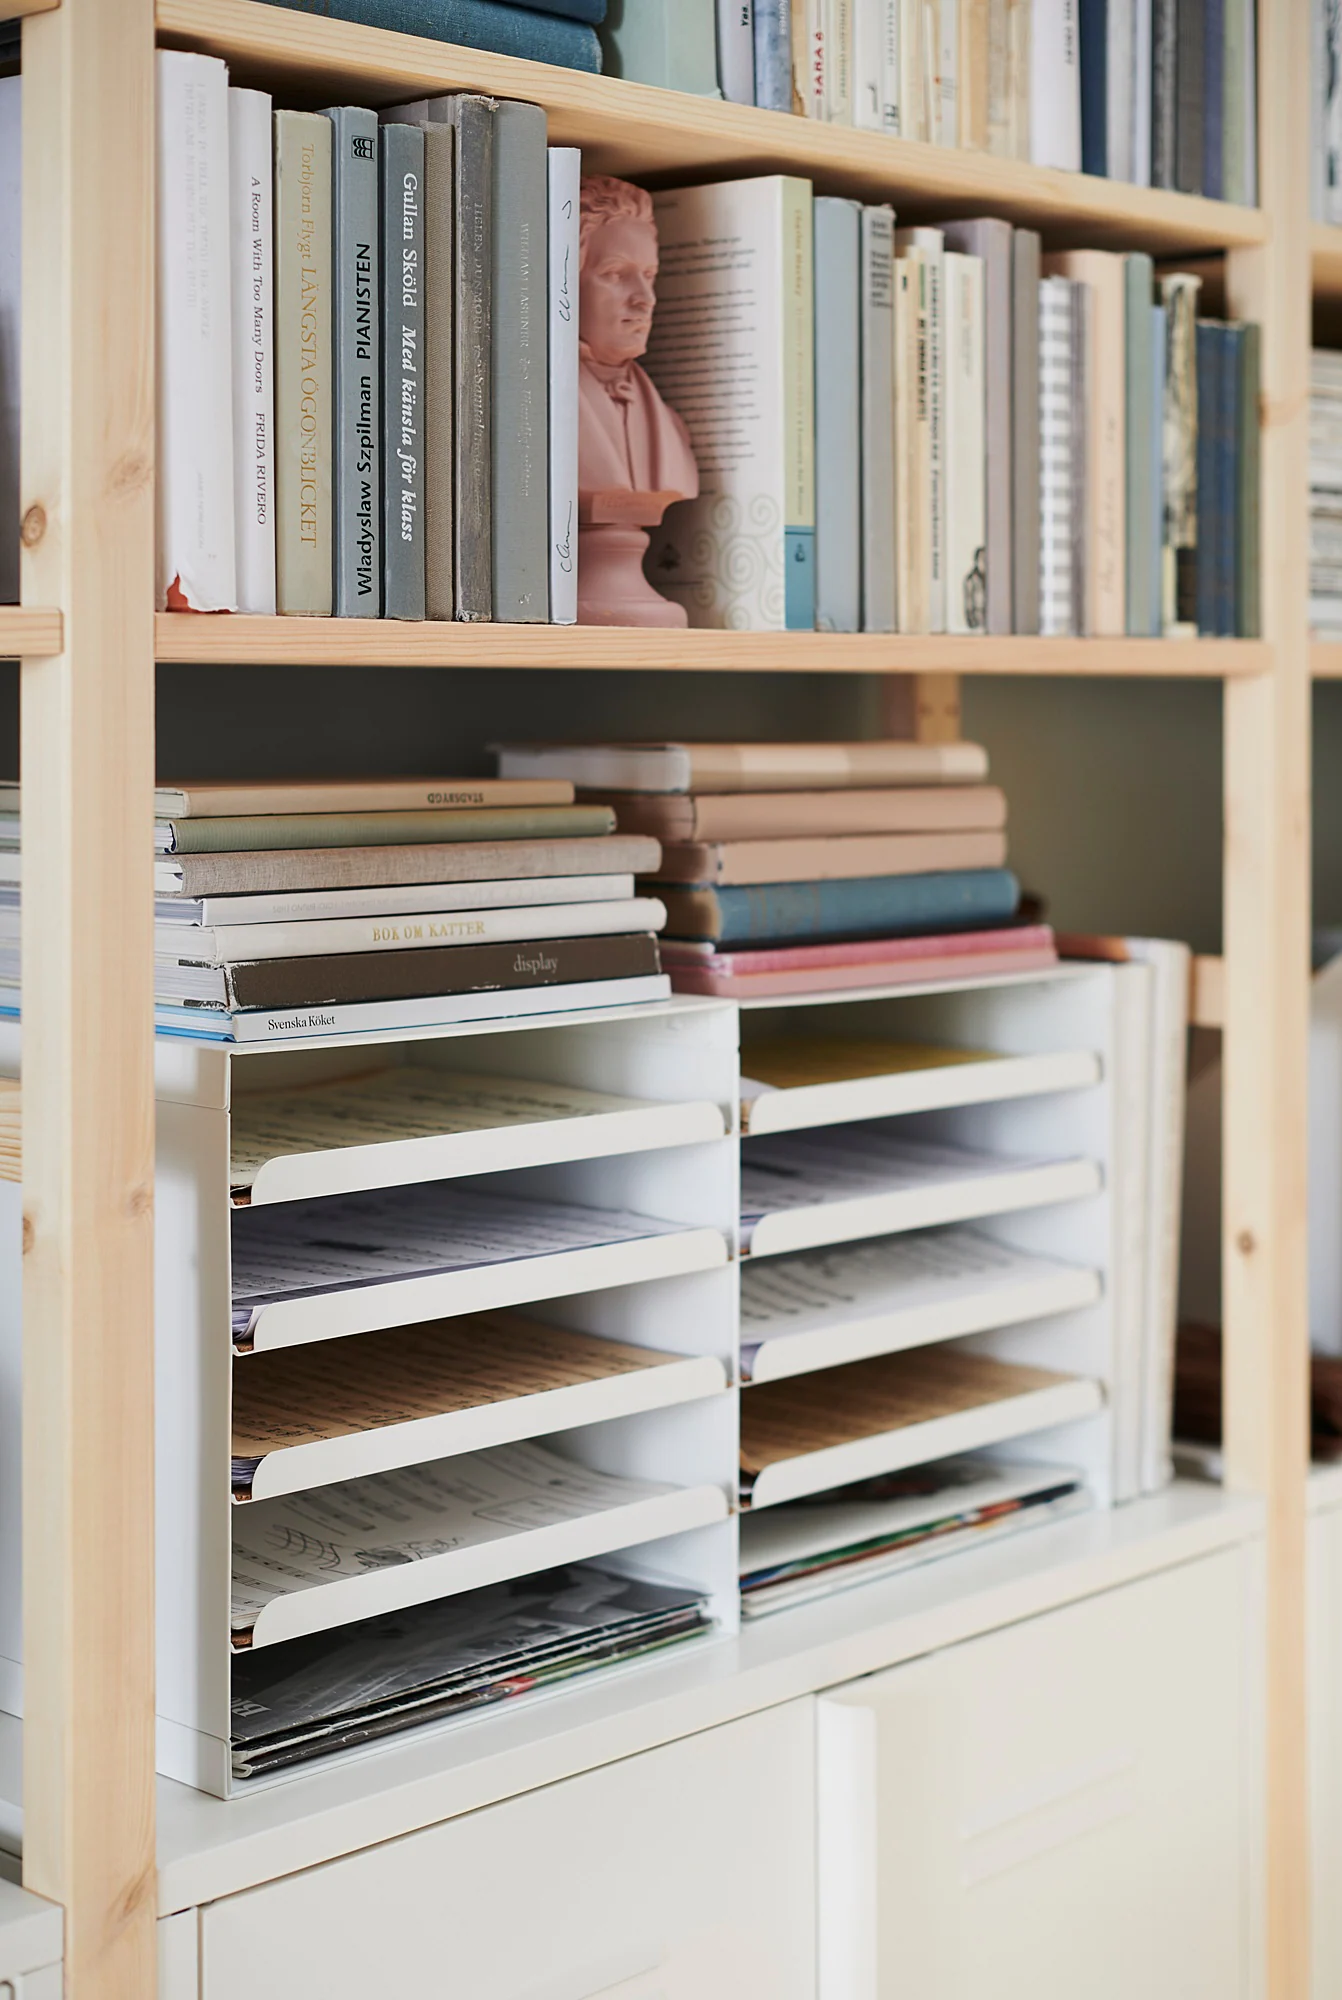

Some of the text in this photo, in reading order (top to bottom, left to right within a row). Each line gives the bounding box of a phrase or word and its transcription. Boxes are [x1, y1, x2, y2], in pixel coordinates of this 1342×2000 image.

[474, 202, 484, 252] HELEN
[519, 222, 530, 281] WILLIAM
[251, 176, 265, 394] A Room With Too Many Doors
[473, 257, 484, 335] DUNMORE
[297, 144, 319, 549] Torbjörn Flygt LÄNGSTA ÖGONBLICKET
[397, 172, 418, 542] Gullan Sköld Med känsla för klass
[356, 243, 375, 596] Wladyslaw Szpilman PIANISTEN
[255, 412, 267, 525] FRIDA RIVERO
[373, 919, 486, 942] BOK OM KATTER
[513, 952, 559, 976] display
[267, 1014, 336, 1031] Svenska Köket
